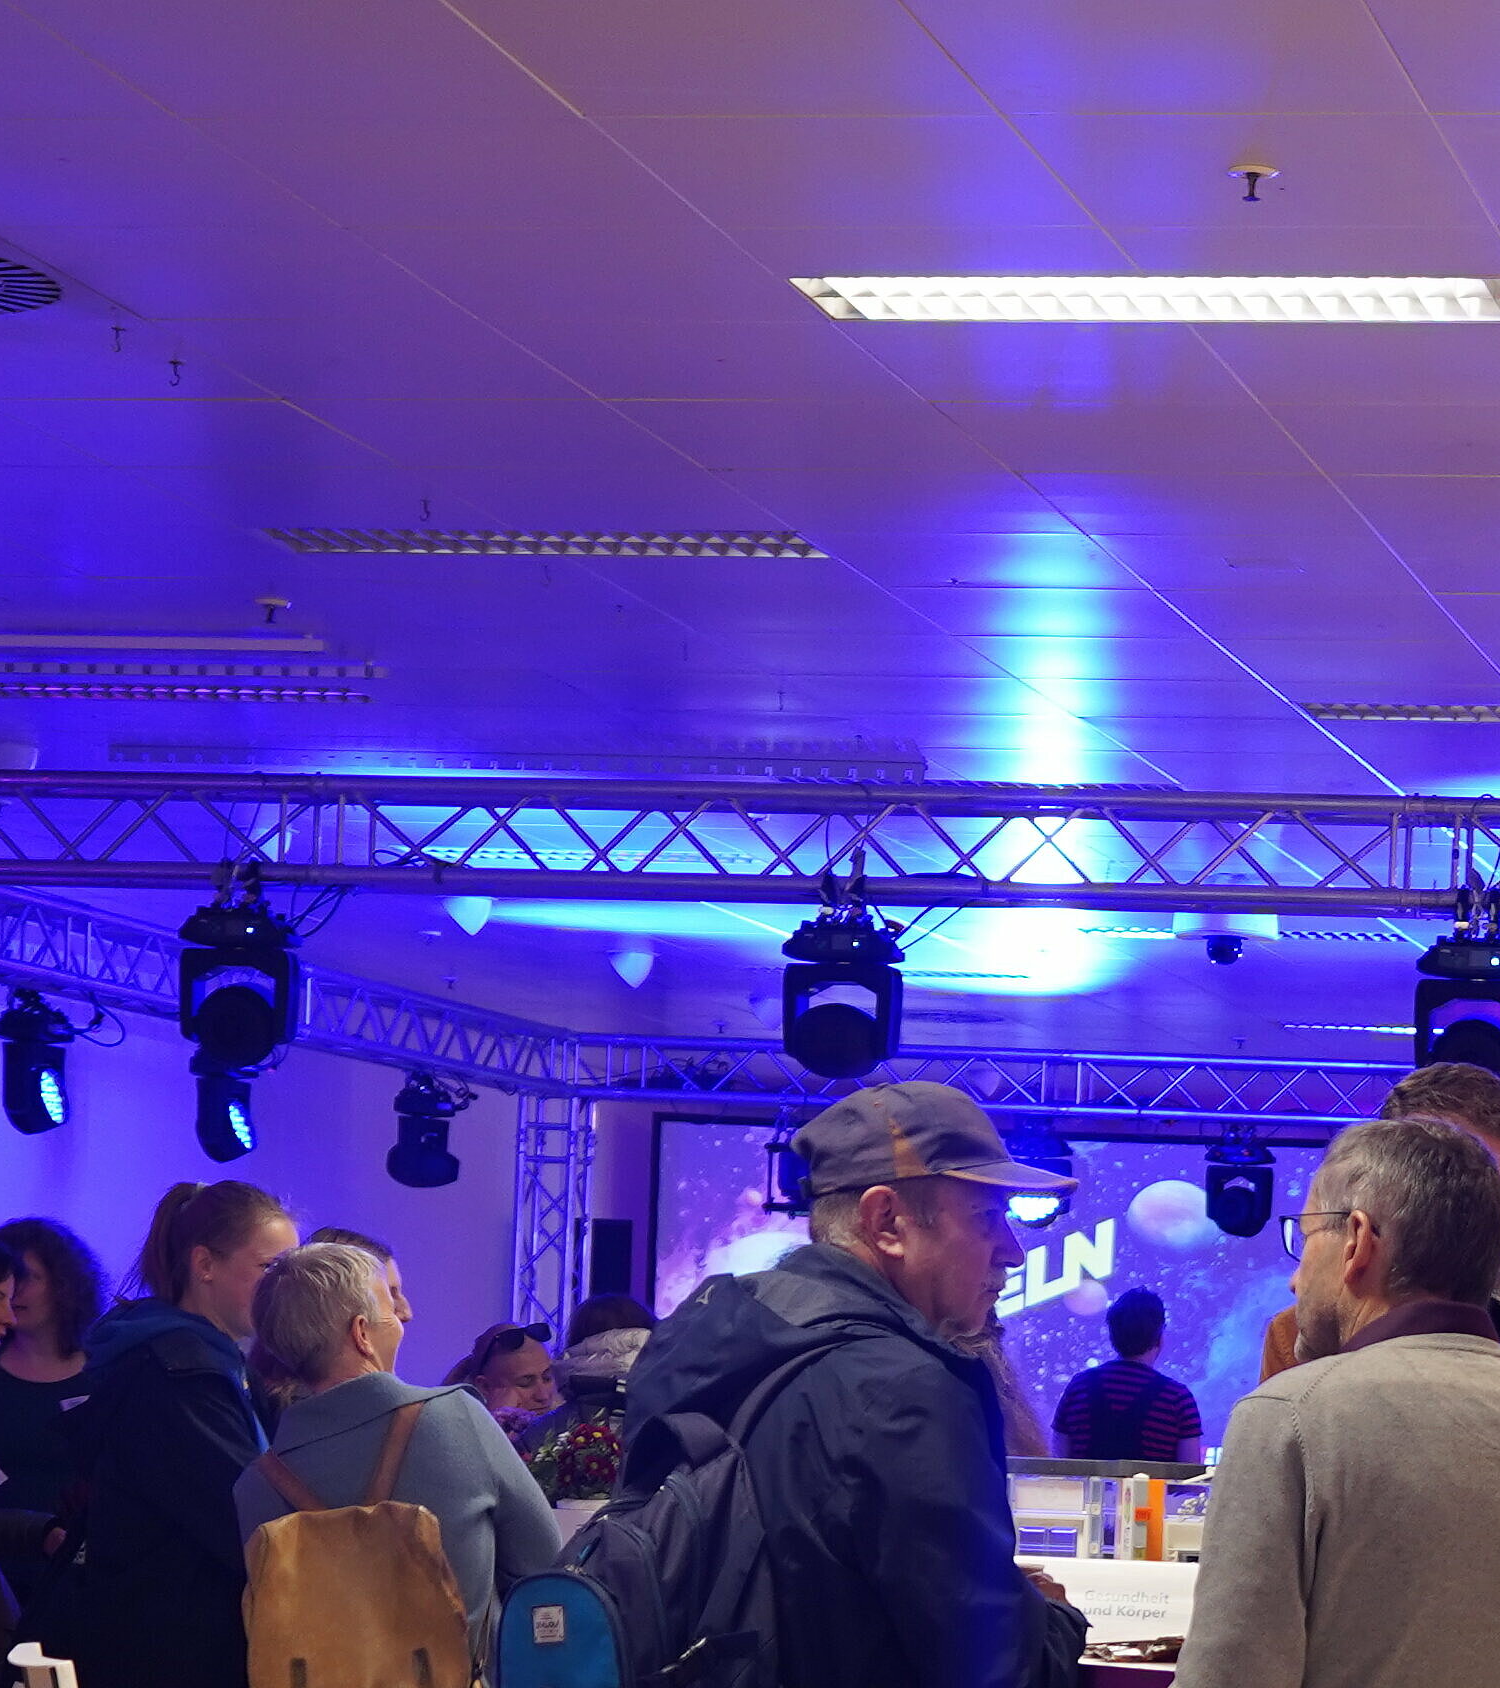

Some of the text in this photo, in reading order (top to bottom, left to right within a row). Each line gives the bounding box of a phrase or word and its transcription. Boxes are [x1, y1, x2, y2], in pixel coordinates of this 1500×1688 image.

[1084, 1590, 1169, 1604] Gesundheit
[1083, 1604, 1167, 1620] und Körper
